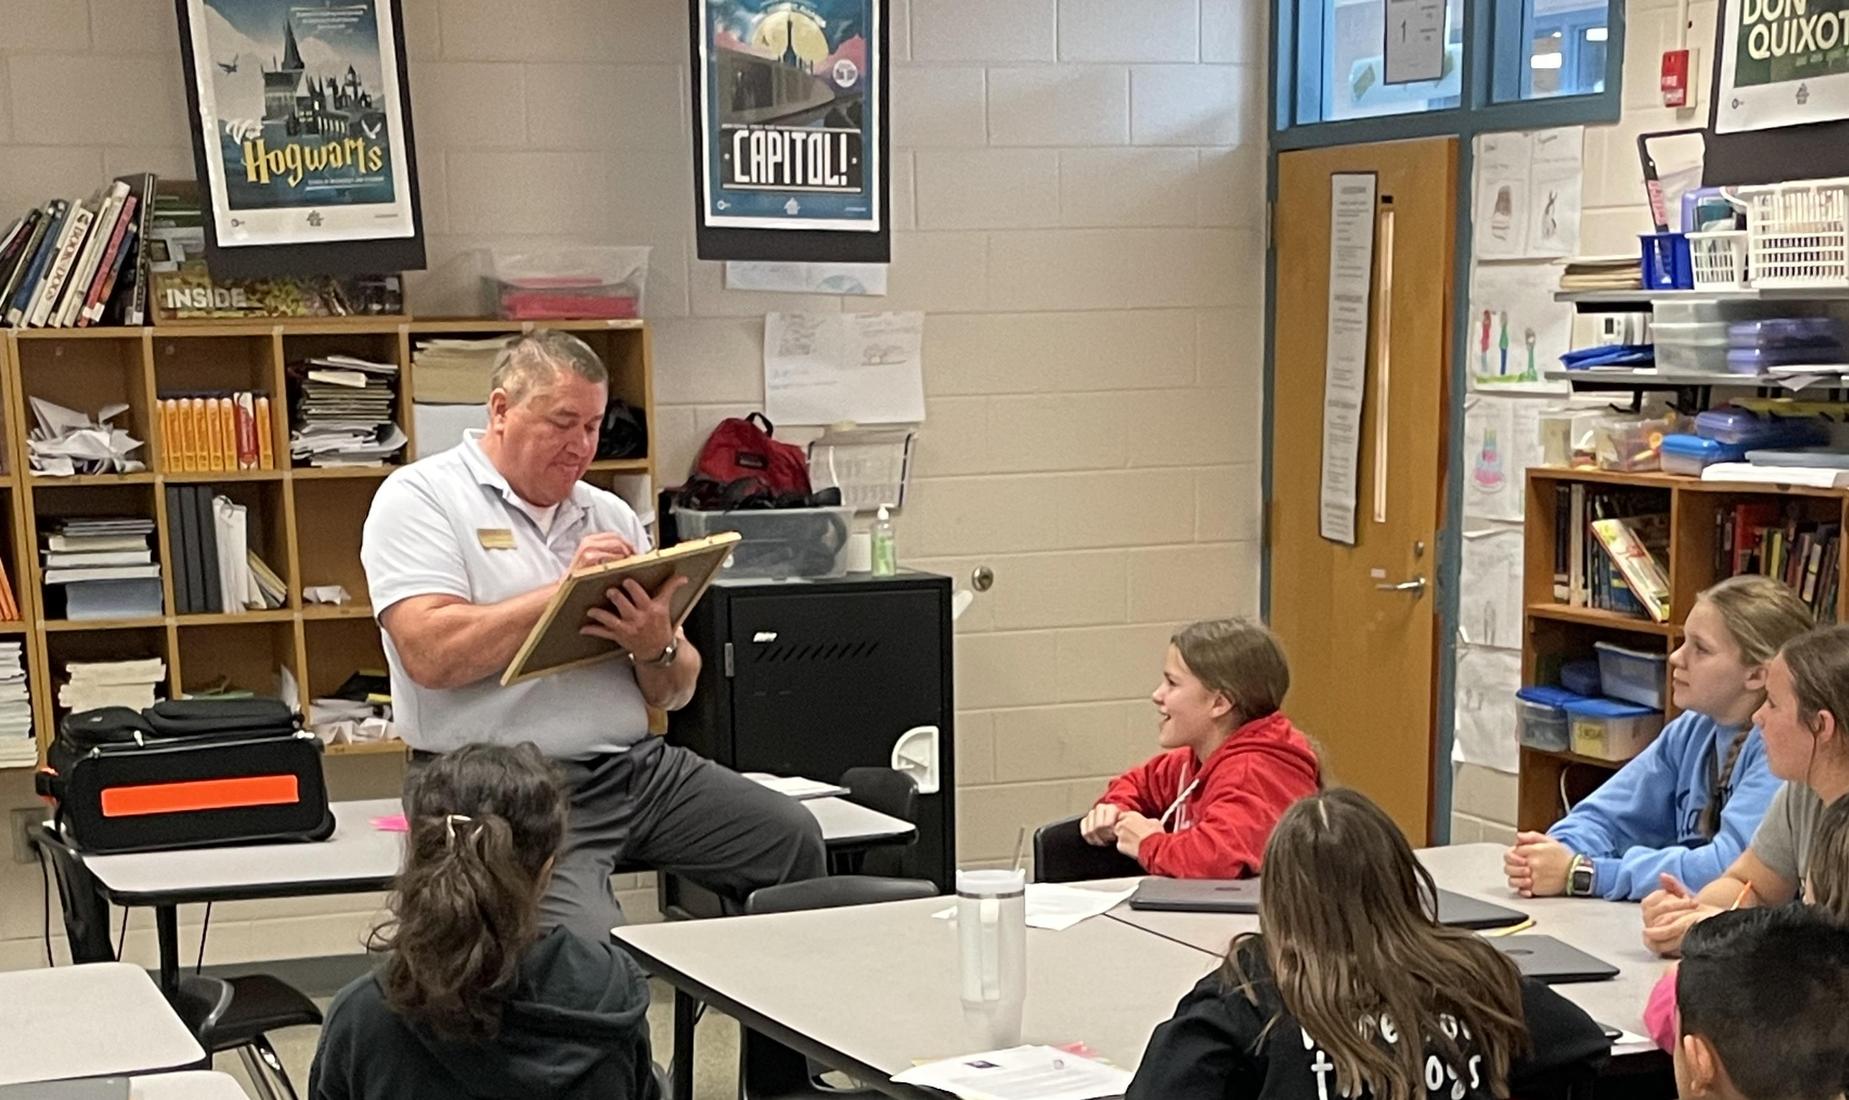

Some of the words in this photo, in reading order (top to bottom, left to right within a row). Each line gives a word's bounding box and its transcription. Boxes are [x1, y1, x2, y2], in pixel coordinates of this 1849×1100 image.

[243, 137, 383, 187] Hogwarts
[733, 129, 848, 186] CAPITOL!
[166, 287, 248, 309] INSIDE
